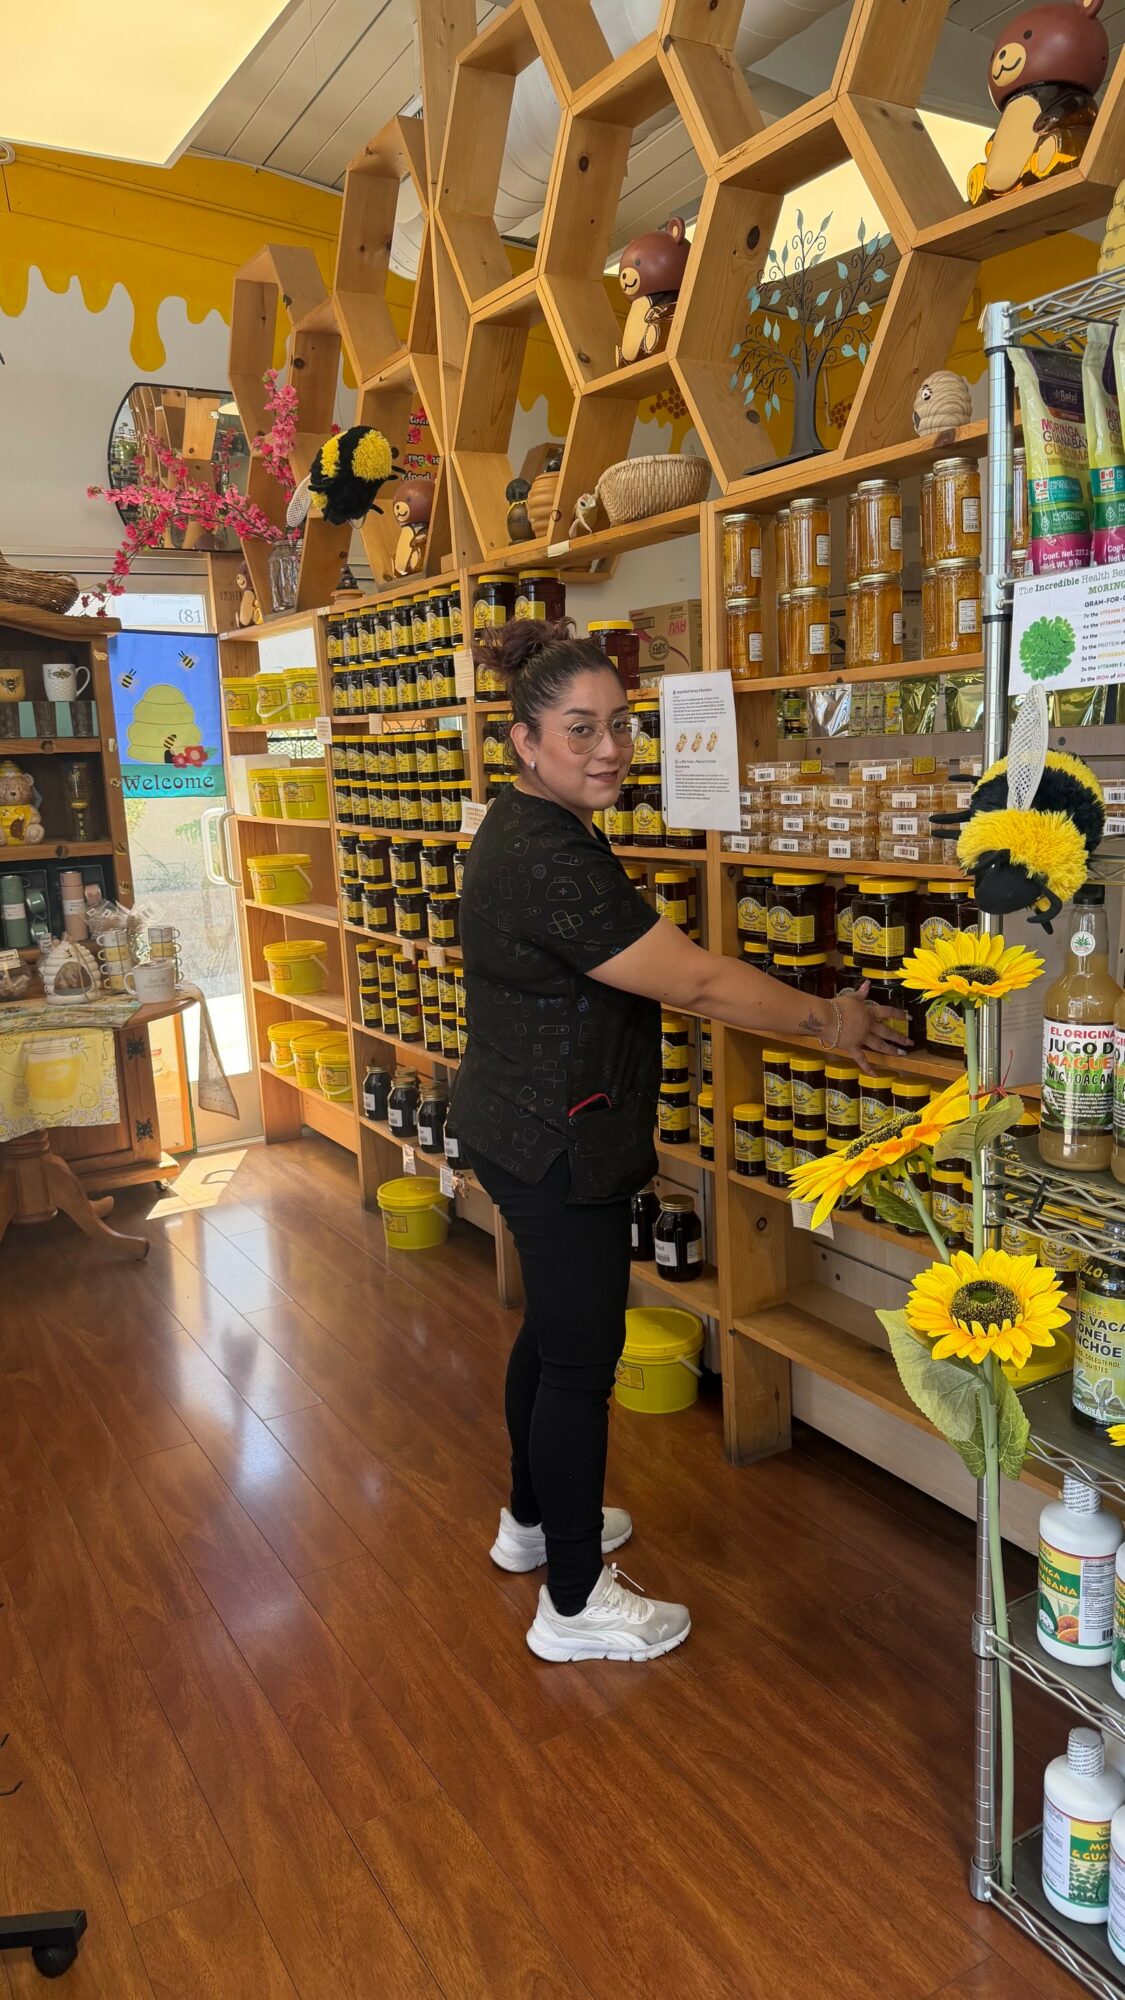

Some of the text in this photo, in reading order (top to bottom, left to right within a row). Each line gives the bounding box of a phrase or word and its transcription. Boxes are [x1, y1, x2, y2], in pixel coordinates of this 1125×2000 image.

[1041, 418, 1080, 438] MORINGA
[1042, 552, 1060, 560] Cont.
[1062, 550, 1074, 558] Net.
[1108, 544, 1125, 553] Cont.
[1056, 560, 1068, 568] Wt.
[1019, 586, 1034, 596] The
[1035, 577, 1080, 592] Incredible
[1081, 570, 1110, 584] Health
[122, 774, 214, 792] Welcome
[1050, 1026, 1062, 1036] EL
[1049, 1038, 1097, 1054] JUGO
[1047, 1053, 1112, 1070] MAGUE
[1048, 1069, 1113, 1085] MICHOACAN
[1085, 1353, 1120, 1368] COLESTEROL
[1072, 1849, 1080, 1858] &
